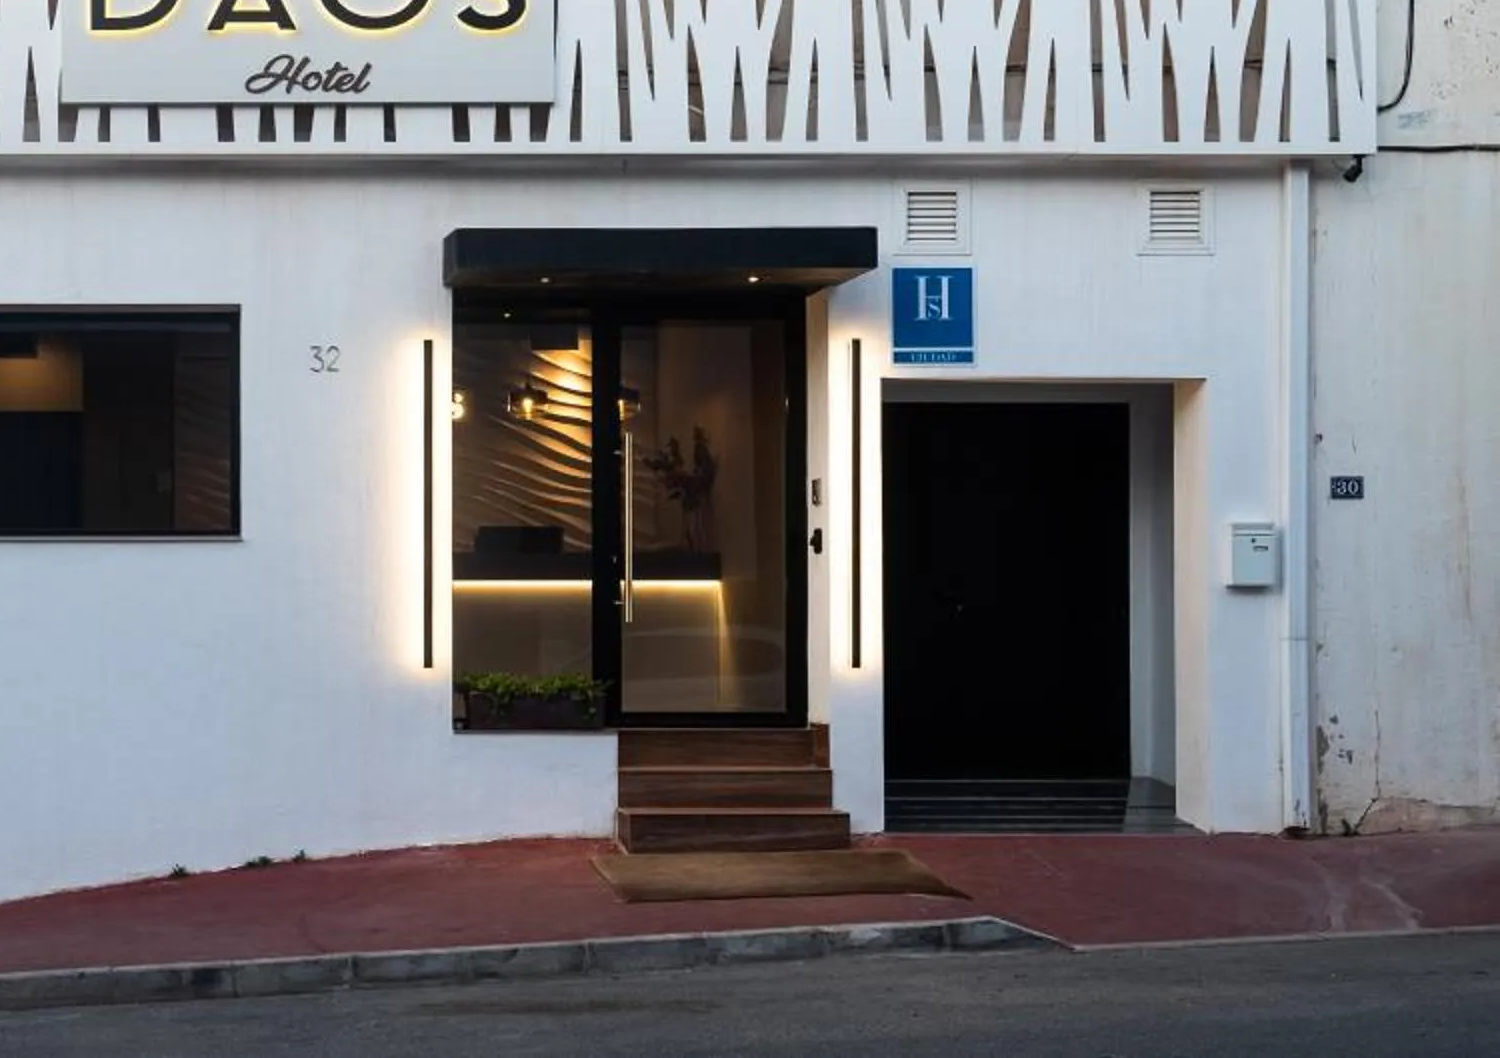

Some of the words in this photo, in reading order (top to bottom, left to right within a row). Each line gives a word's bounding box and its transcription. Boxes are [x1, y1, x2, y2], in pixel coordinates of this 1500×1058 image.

[244, 54, 374, 95] Hotel
[309, 345, 341, 373] 32
[1336, 480, 1360, 495] 30
